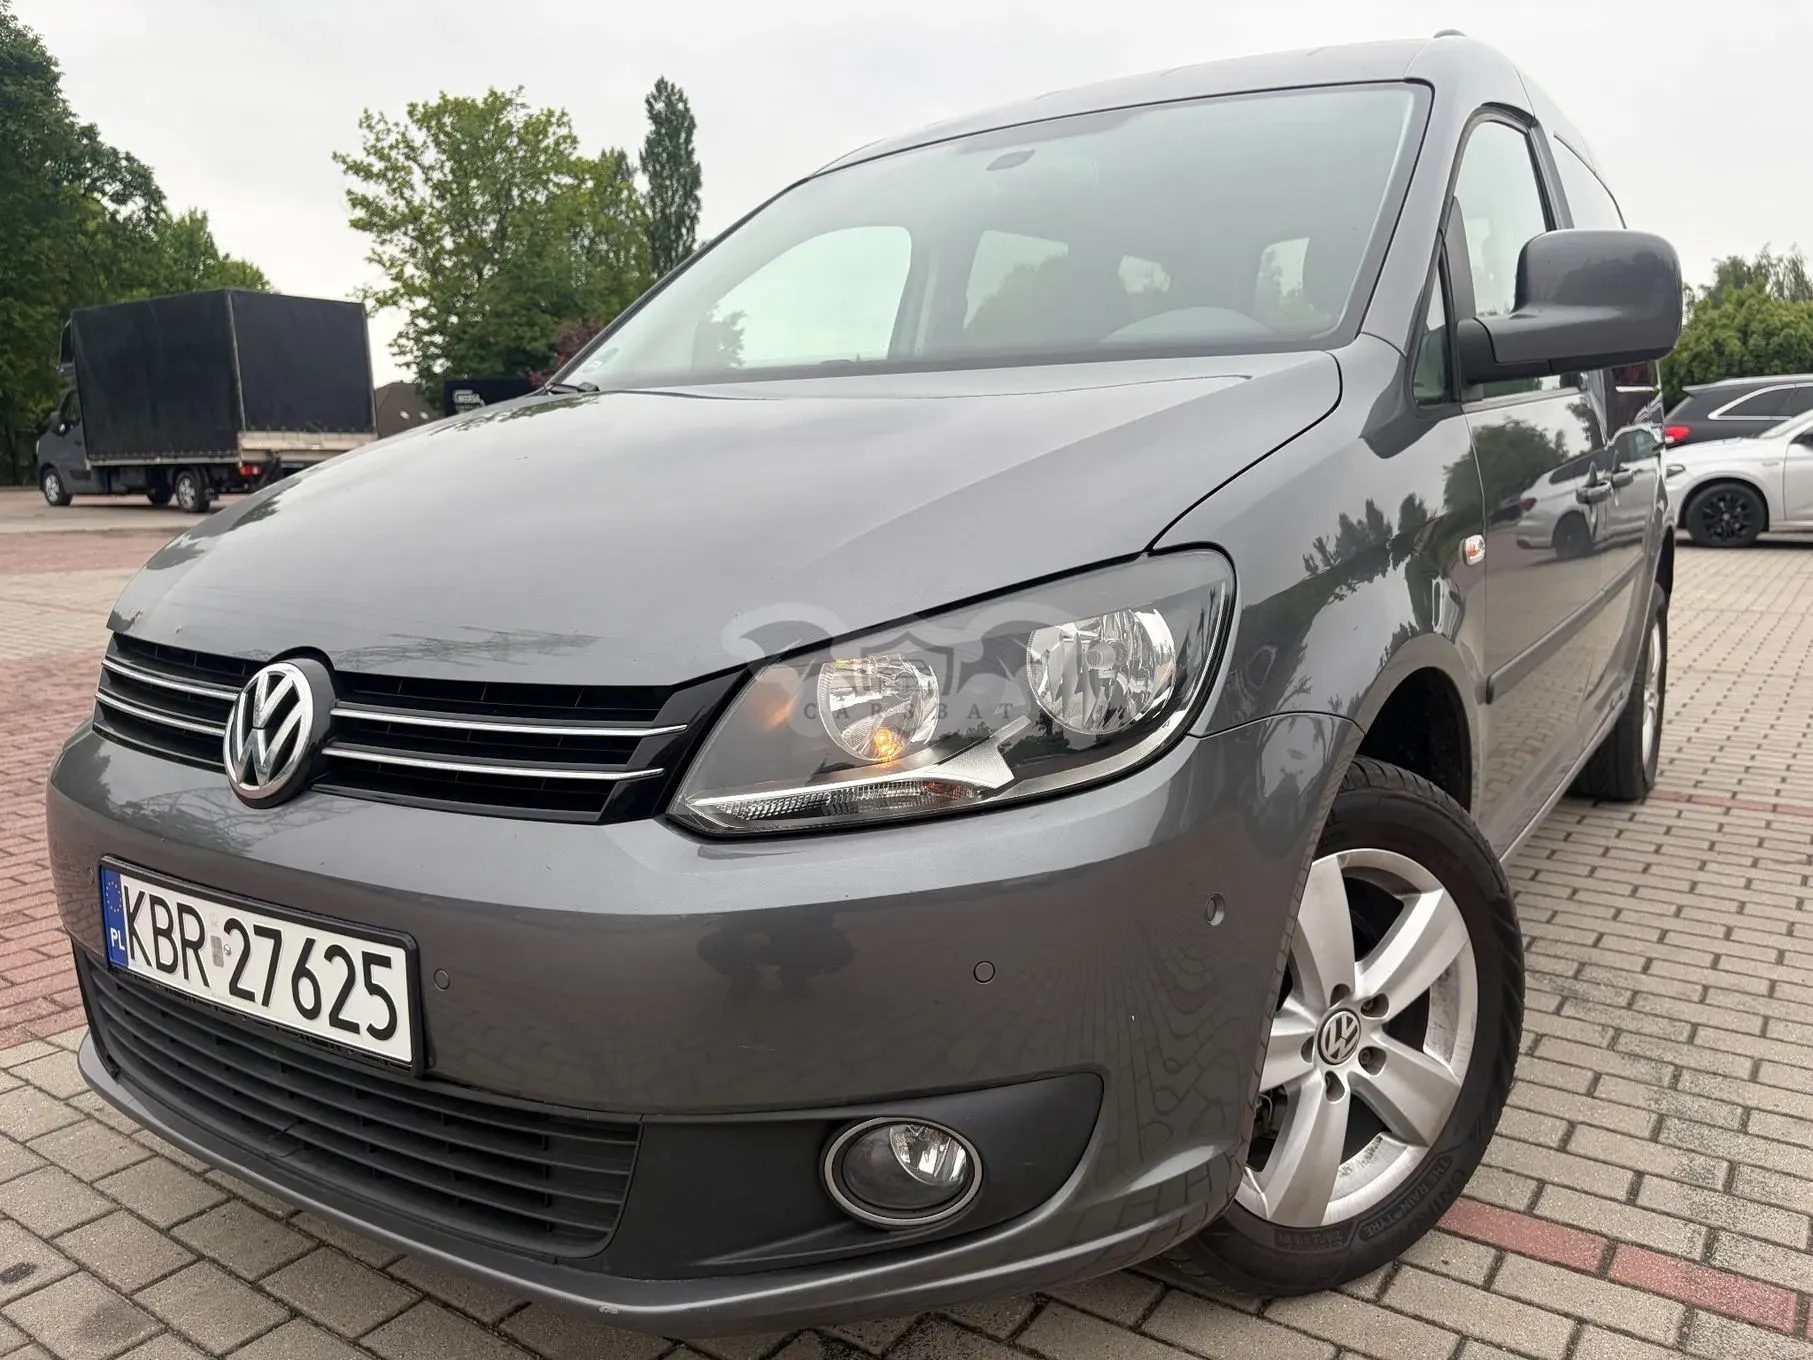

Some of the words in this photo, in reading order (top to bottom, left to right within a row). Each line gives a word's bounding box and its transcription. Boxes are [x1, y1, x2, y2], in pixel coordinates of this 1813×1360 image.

[110, 927, 125, 950] PL
[124, 884, 211, 988] KBR
[223, 917, 399, 1041] 27625
[1429, 1158, 1451, 1185] THE
[1401, 1183, 1429, 1214] RAIN
[1363, 1212, 1394, 1238] TYRE
